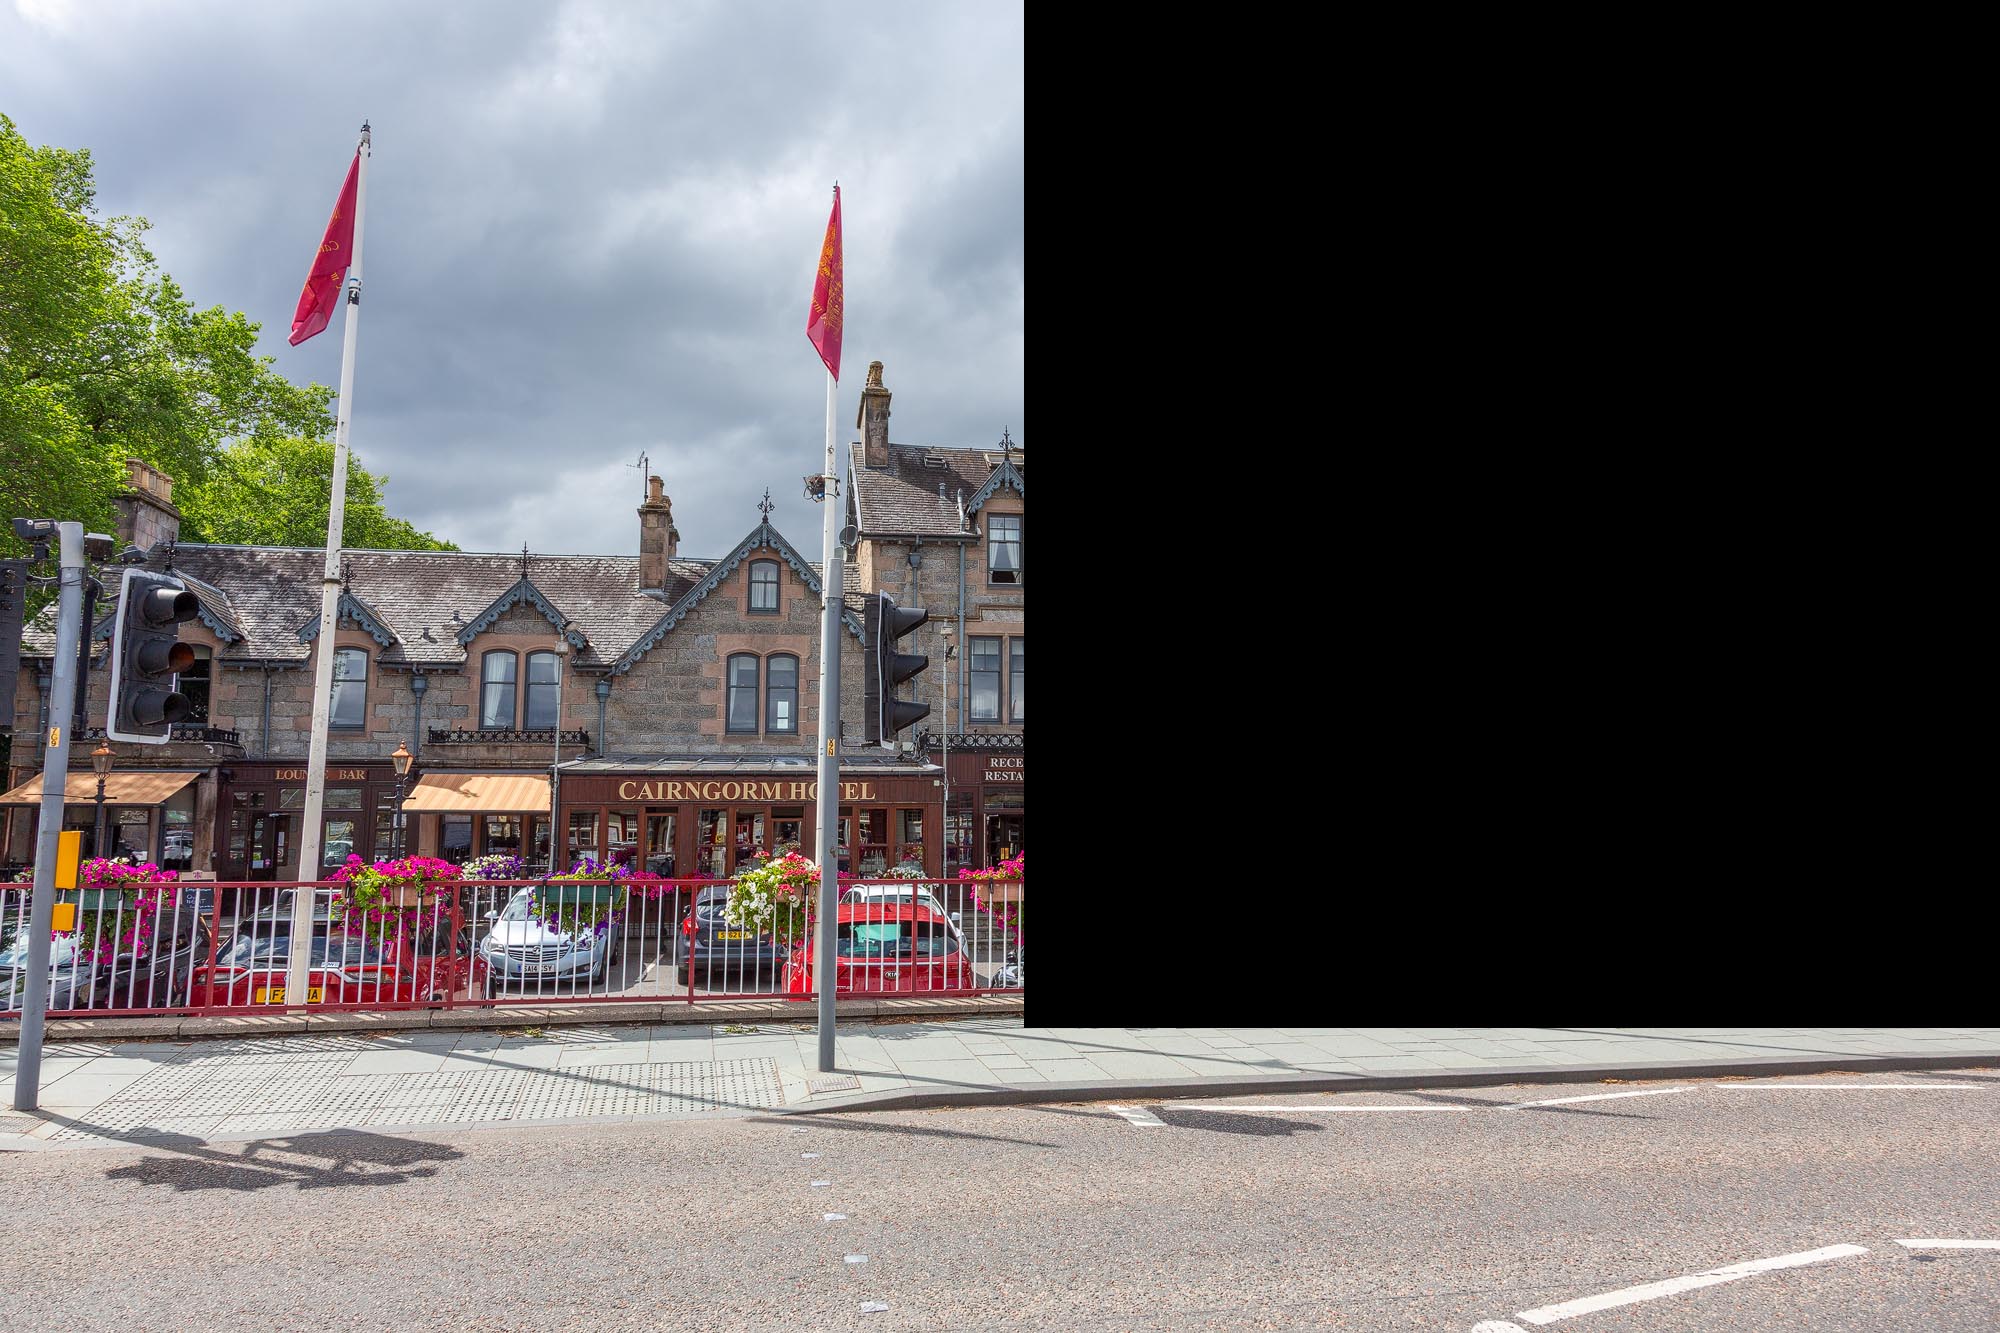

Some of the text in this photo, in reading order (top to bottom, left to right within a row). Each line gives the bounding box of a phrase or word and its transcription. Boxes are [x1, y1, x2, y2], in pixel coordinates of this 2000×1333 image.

[990, 758, 1024, 768] RECE
[340, 769, 366, 780] BAR
[985, 771, 1024, 781] RESTA
[618, 781, 876, 800] CAIRNGORM HOEL
